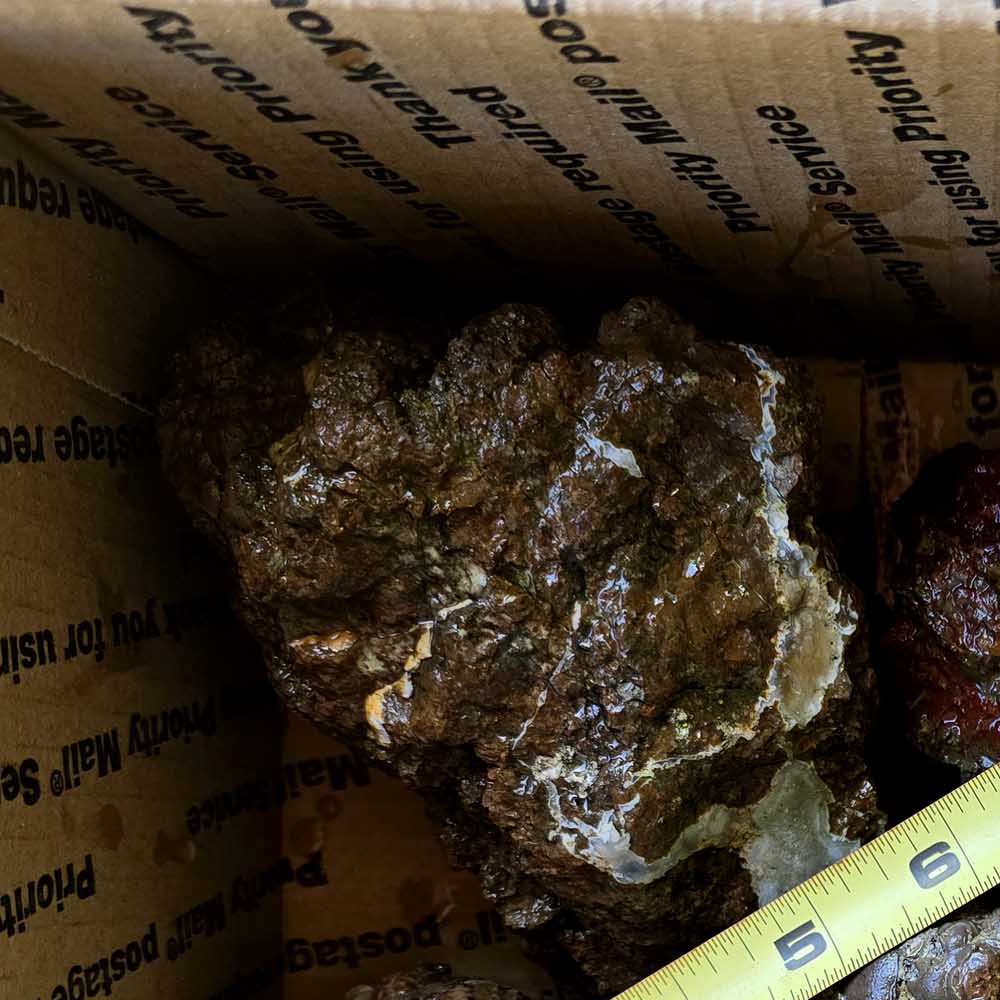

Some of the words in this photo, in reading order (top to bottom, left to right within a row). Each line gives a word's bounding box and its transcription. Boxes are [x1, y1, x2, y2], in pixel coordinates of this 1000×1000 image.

[124, 5, 316, 123] Priority
[342, 60, 476, 150] Thank
[844, 29, 948, 144] Priority
[105, 85, 278, 182] Service
[303, 129, 423, 195] using
[449, 85, 613, 193] required
[756, 102, 858, 199] Service
[919, 148, 990, 210] using
[665, 150, 773, 234] Priority
[64, 617, 104, 662] for
[50, 726, 122, 797] Mail®
[773, 919, 829, 971] 5
[908, 840, 962, 890] 6
